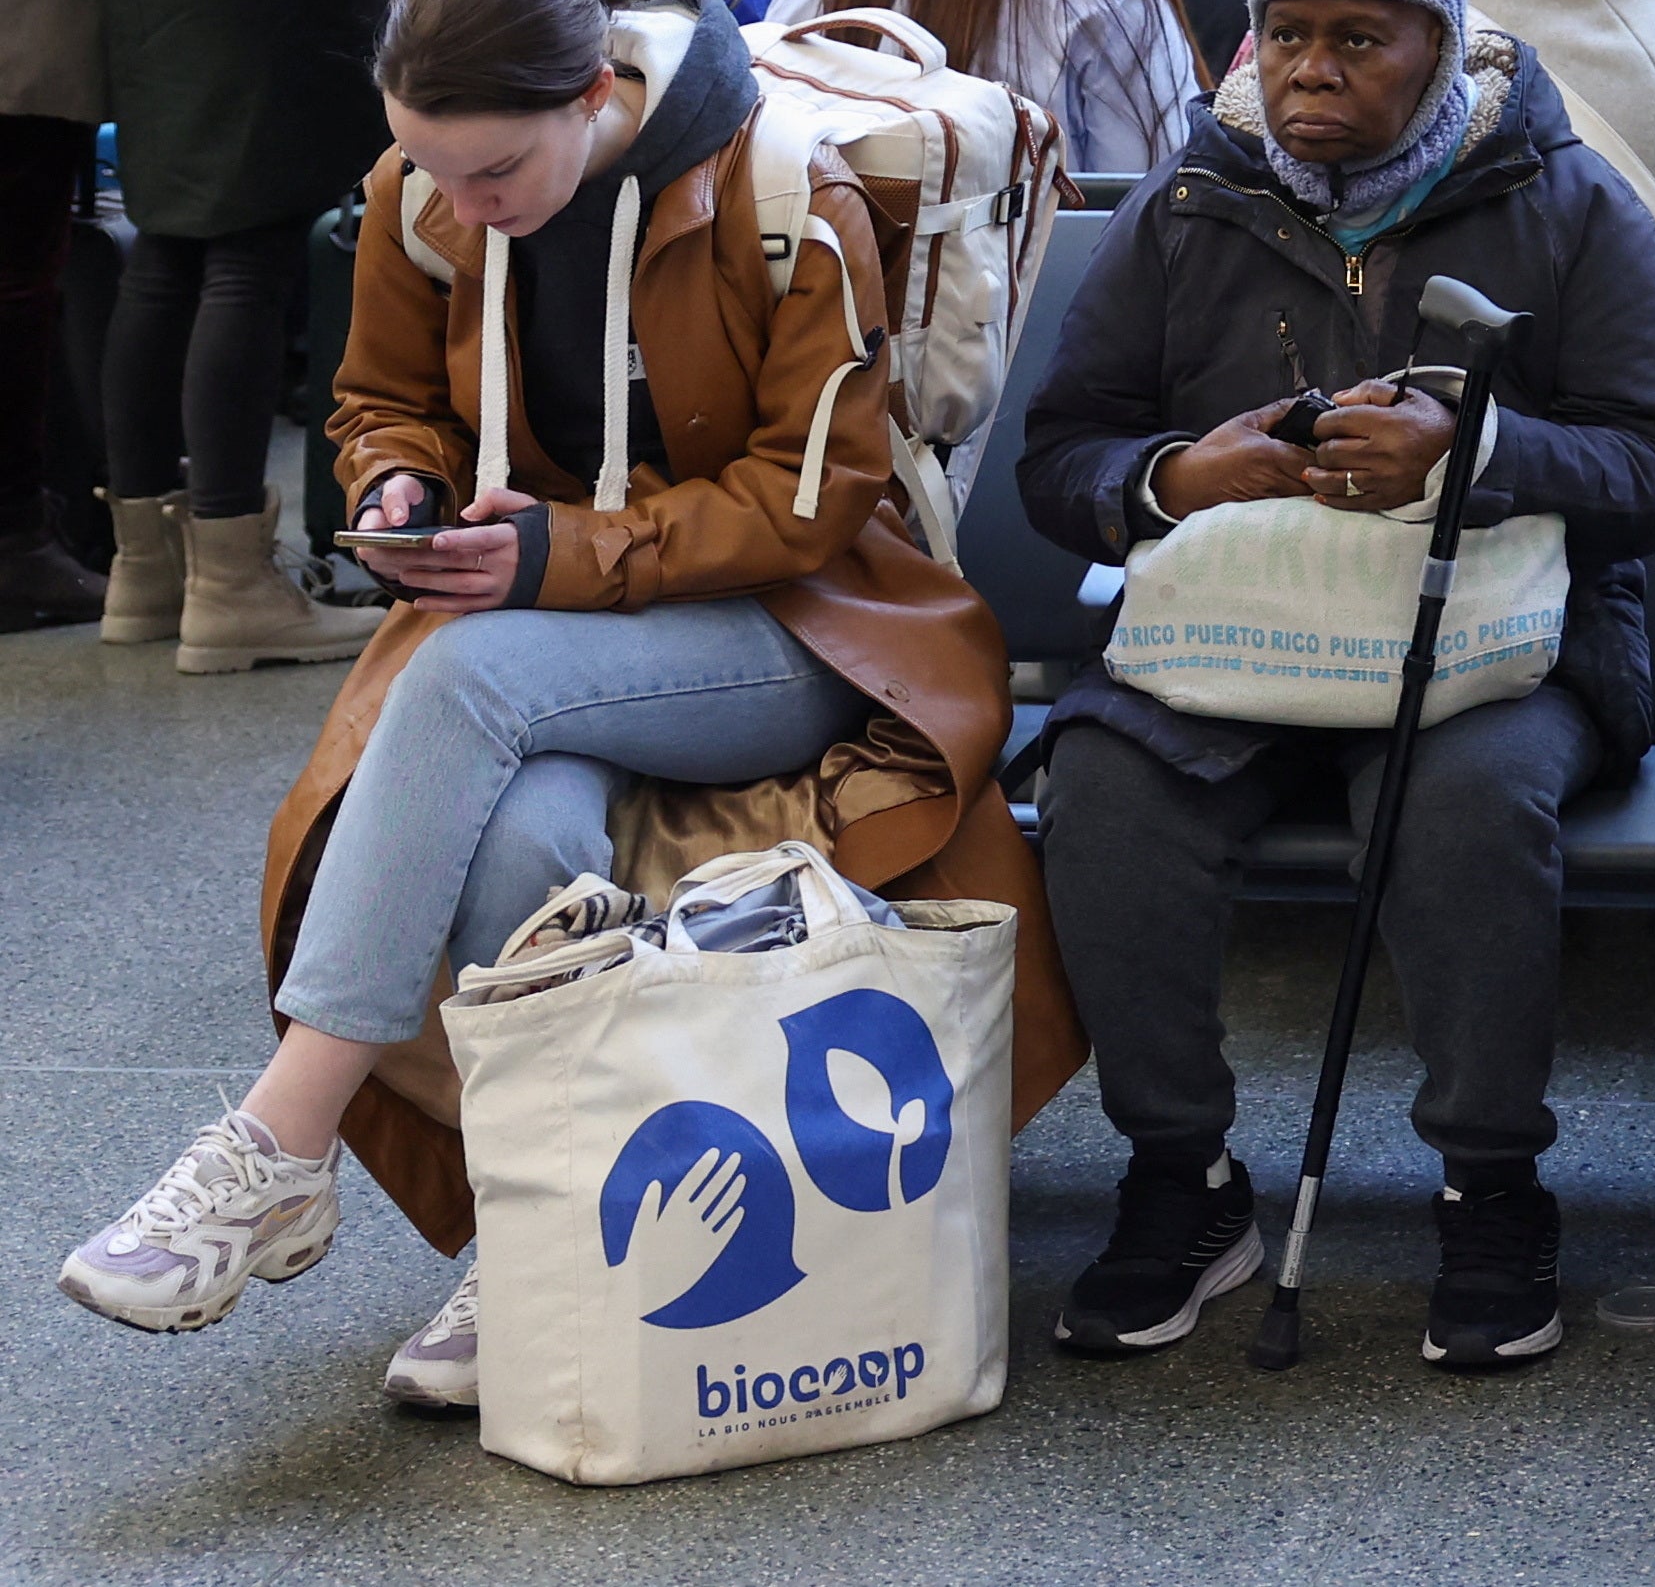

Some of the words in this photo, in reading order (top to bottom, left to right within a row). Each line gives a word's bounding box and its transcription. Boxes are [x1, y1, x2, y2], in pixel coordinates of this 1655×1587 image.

[1132, 624, 1176, 647] RICO
[1184, 623, 1266, 649] PUERTO
[1271, 629, 1320, 655] RICO
[1478, 609, 1556, 644] PUERTO
[697, 1342, 925, 1418] biocoop
[699, 1427, 716, 1438] LA
[724, 1422, 750, 1434] BIO
[758, 1413, 798, 1429] NOUS
